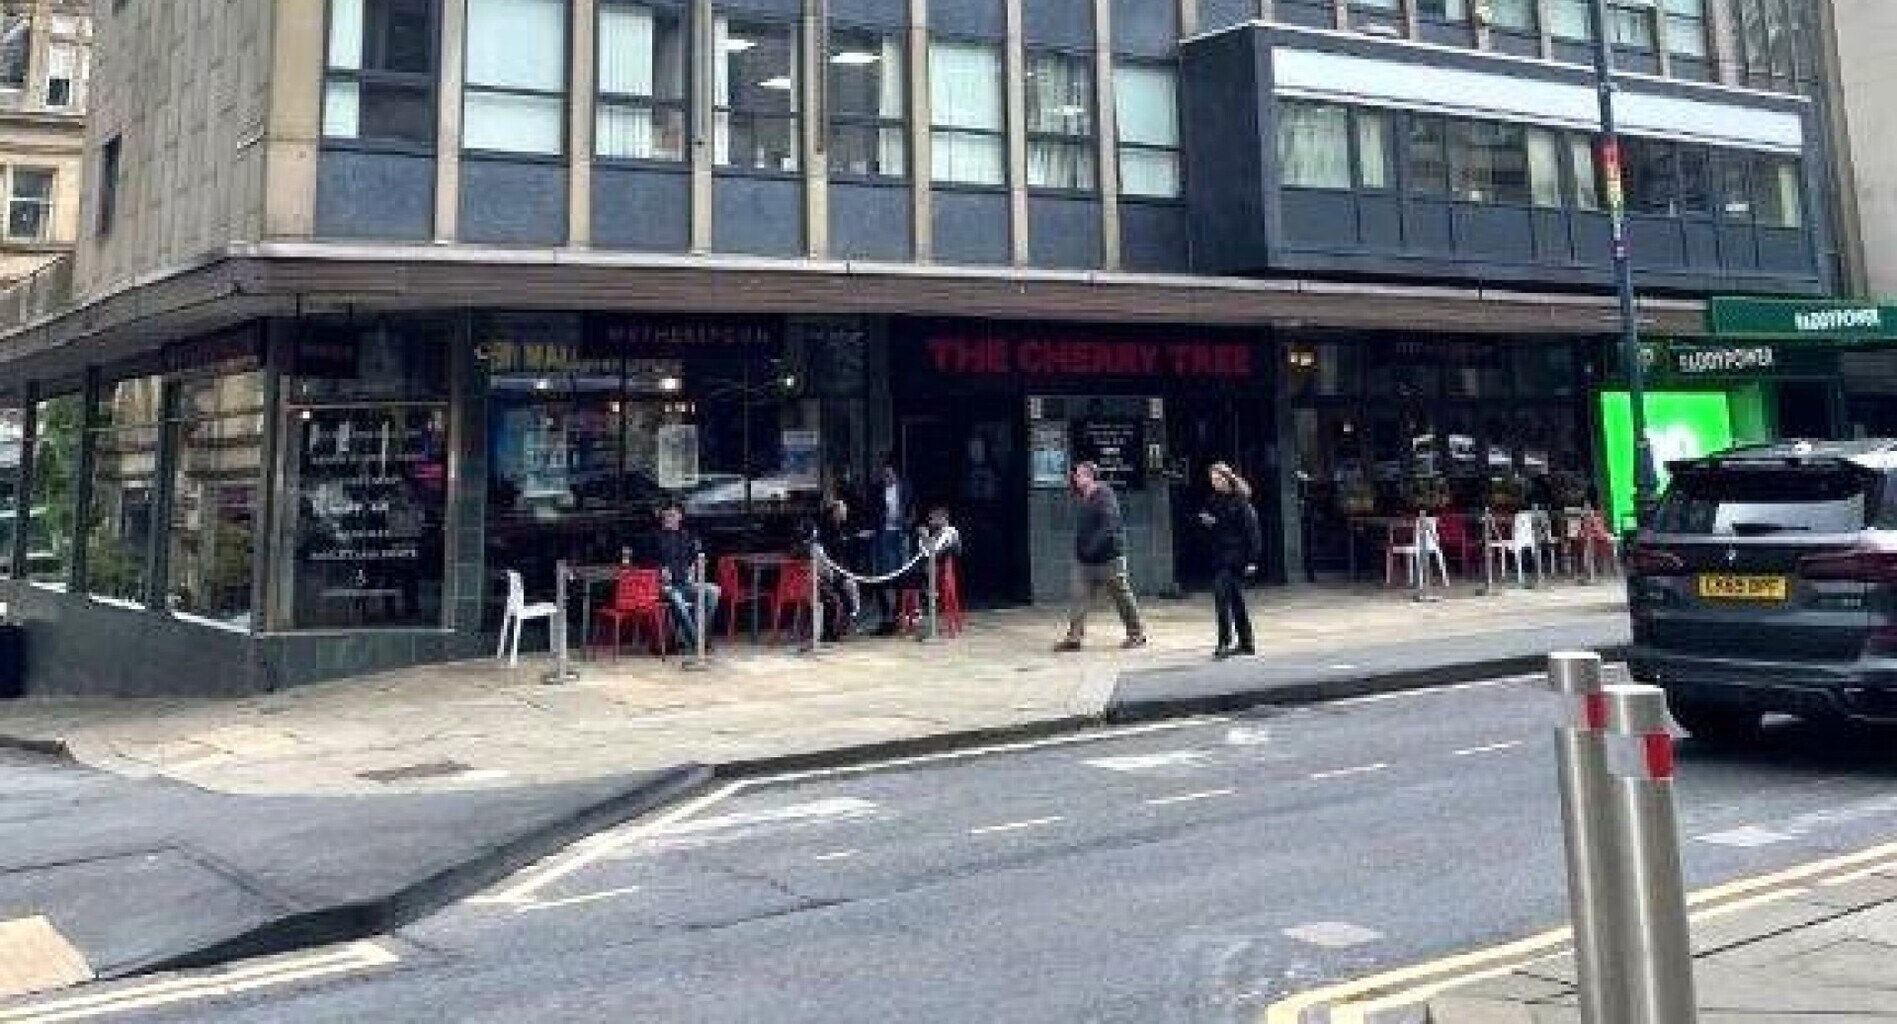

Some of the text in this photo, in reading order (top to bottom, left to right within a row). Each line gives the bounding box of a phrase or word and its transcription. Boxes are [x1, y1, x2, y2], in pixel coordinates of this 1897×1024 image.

[924, 339, 1251, 373] THE CHERRY TREE
